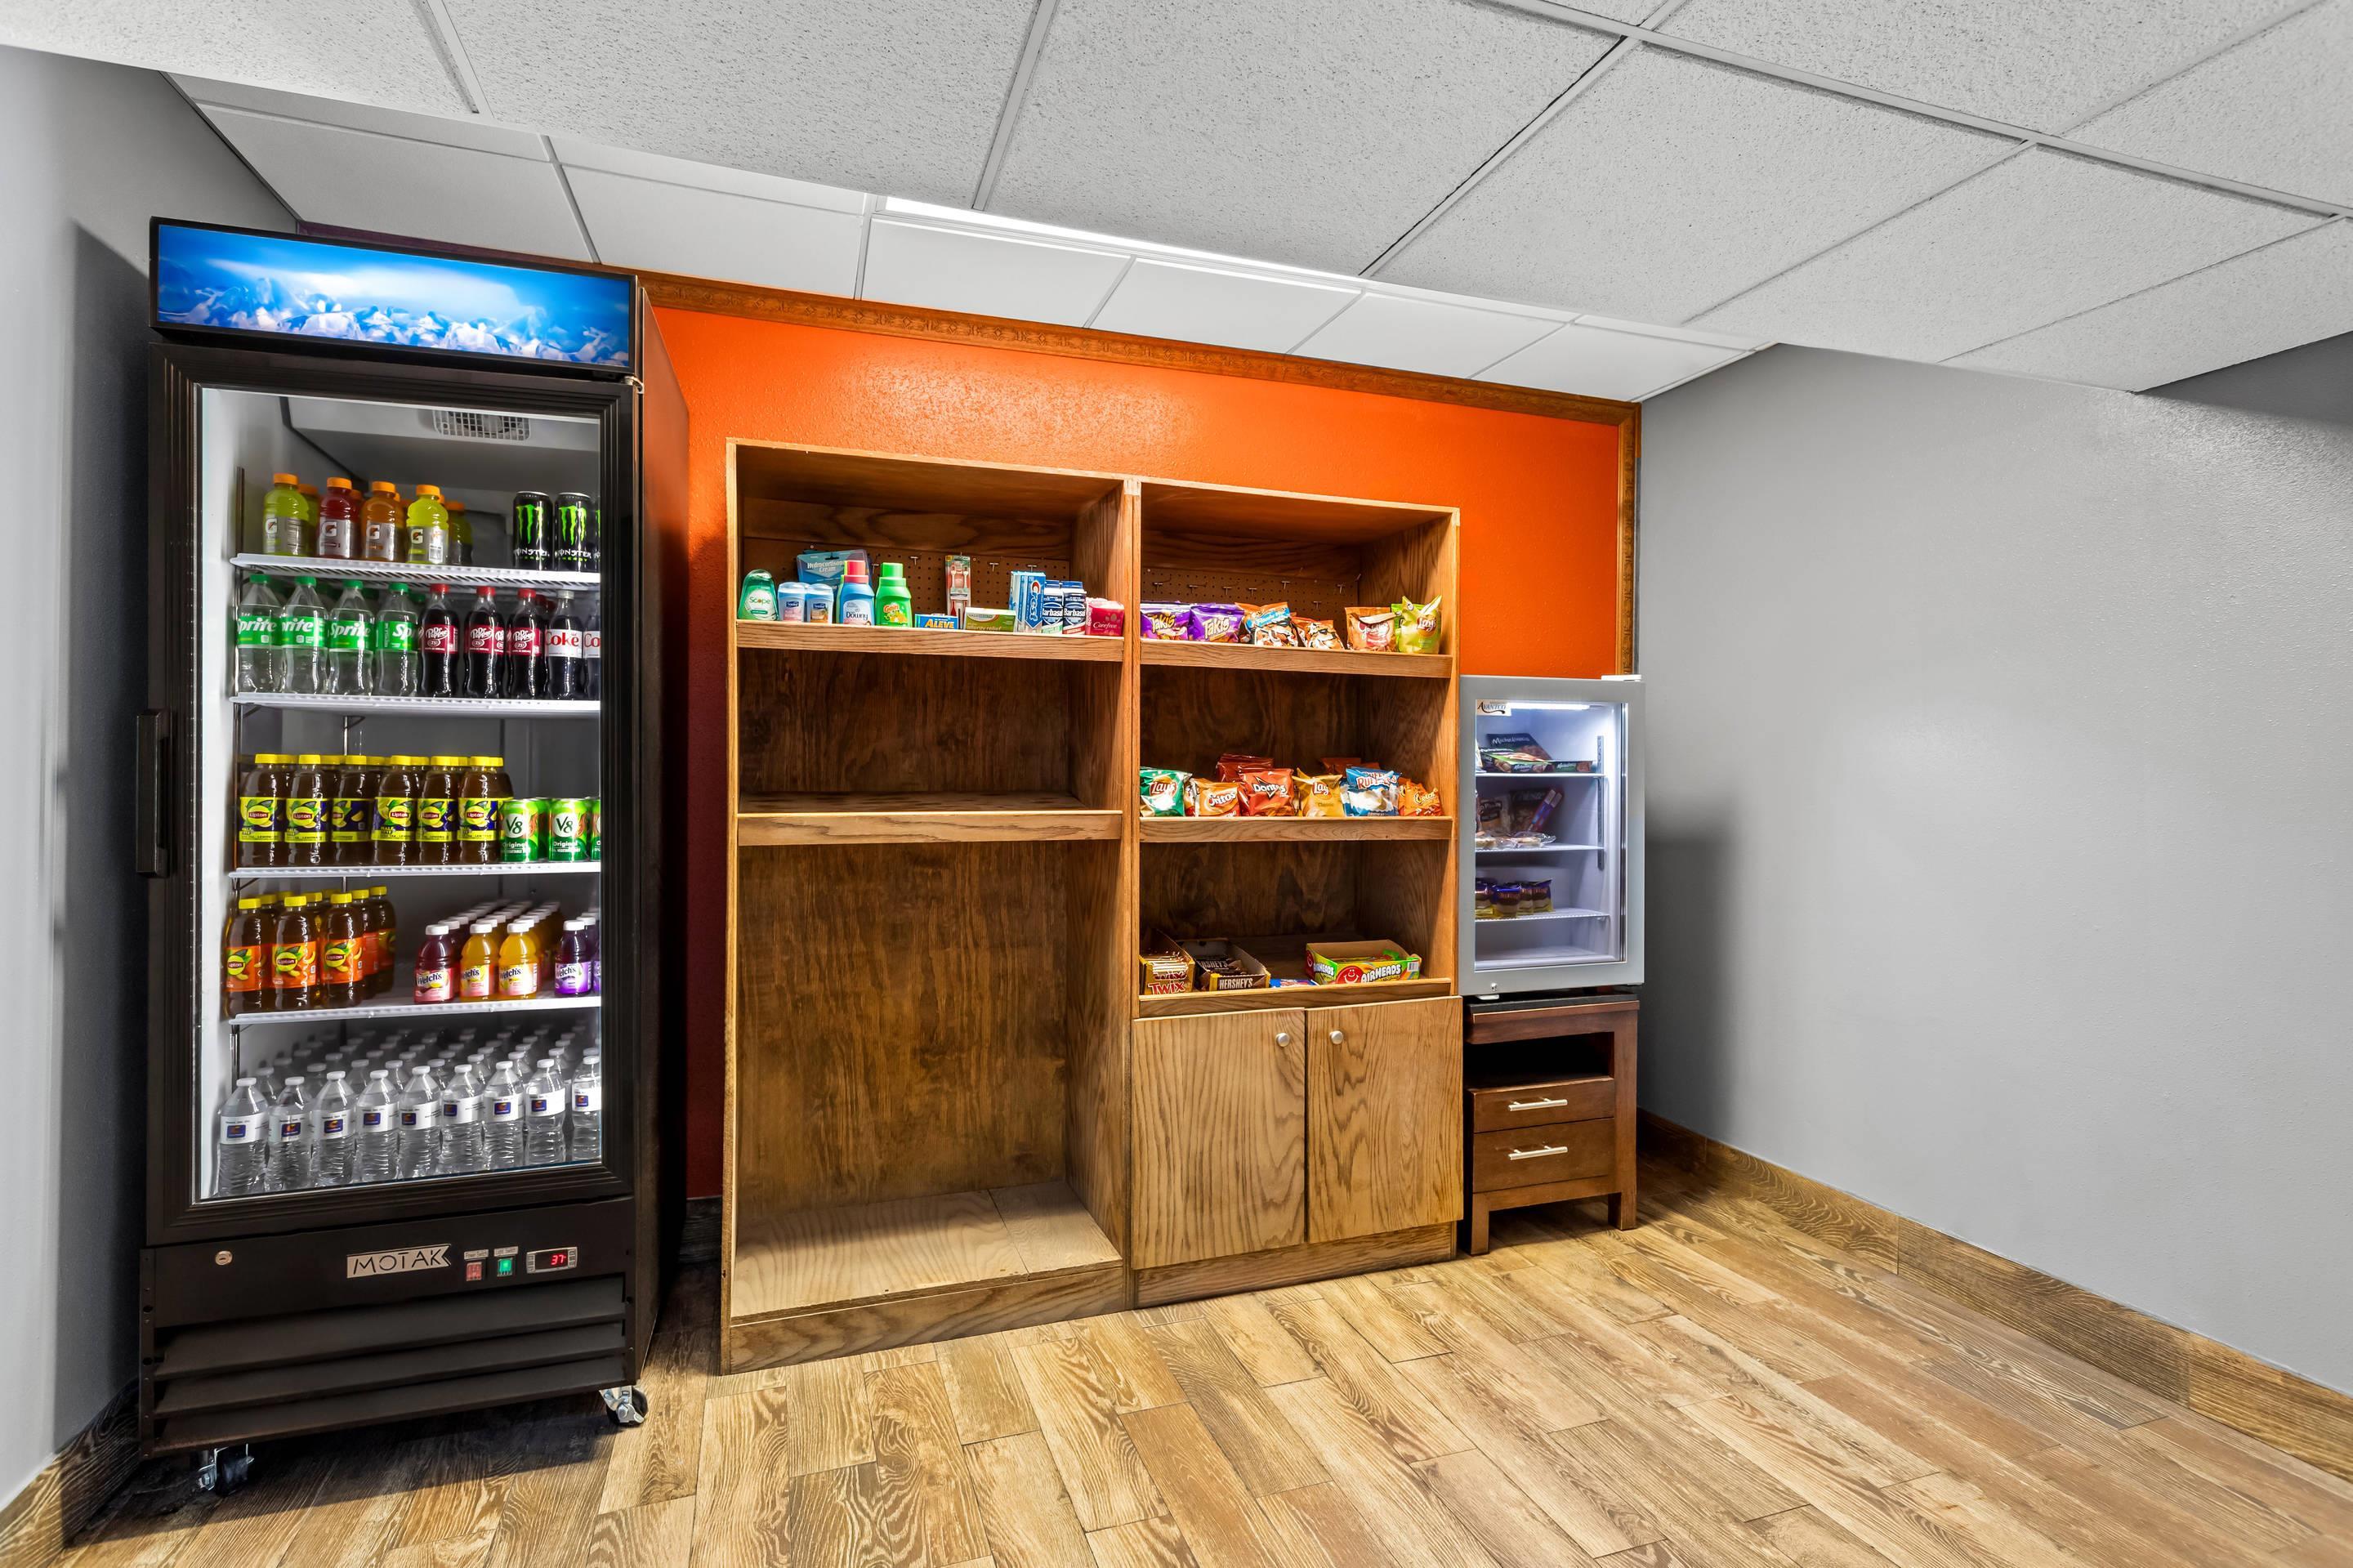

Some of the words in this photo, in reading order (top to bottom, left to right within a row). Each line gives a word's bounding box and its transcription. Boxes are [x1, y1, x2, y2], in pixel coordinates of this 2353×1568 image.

[807, 561, 845, 569] Hydrocortison
[749, 596, 771, 605] Scope
[1029, 580, 1041, 621] Crest
[846, 611, 868, 620] Downy
[330, 622, 371, 638] Sprie
[1093, 621, 1118, 629] Carefree
[1150, 613, 1176, 634] Takis
[1203, 618, 1230, 640] Takis
[584, 633, 600, 648] Co
[506, 816, 523, 834] V8
[556, 815, 574, 833] V8
[1199, 960, 1229, 968] ERSHEY'S
[462, 968, 480, 980] elch's
[1360, 964, 1402, 983] AIRHEADS
[1219, 977, 1253, 990] HERSHEY'S
[353, 1249, 441, 1275] MOTAK
